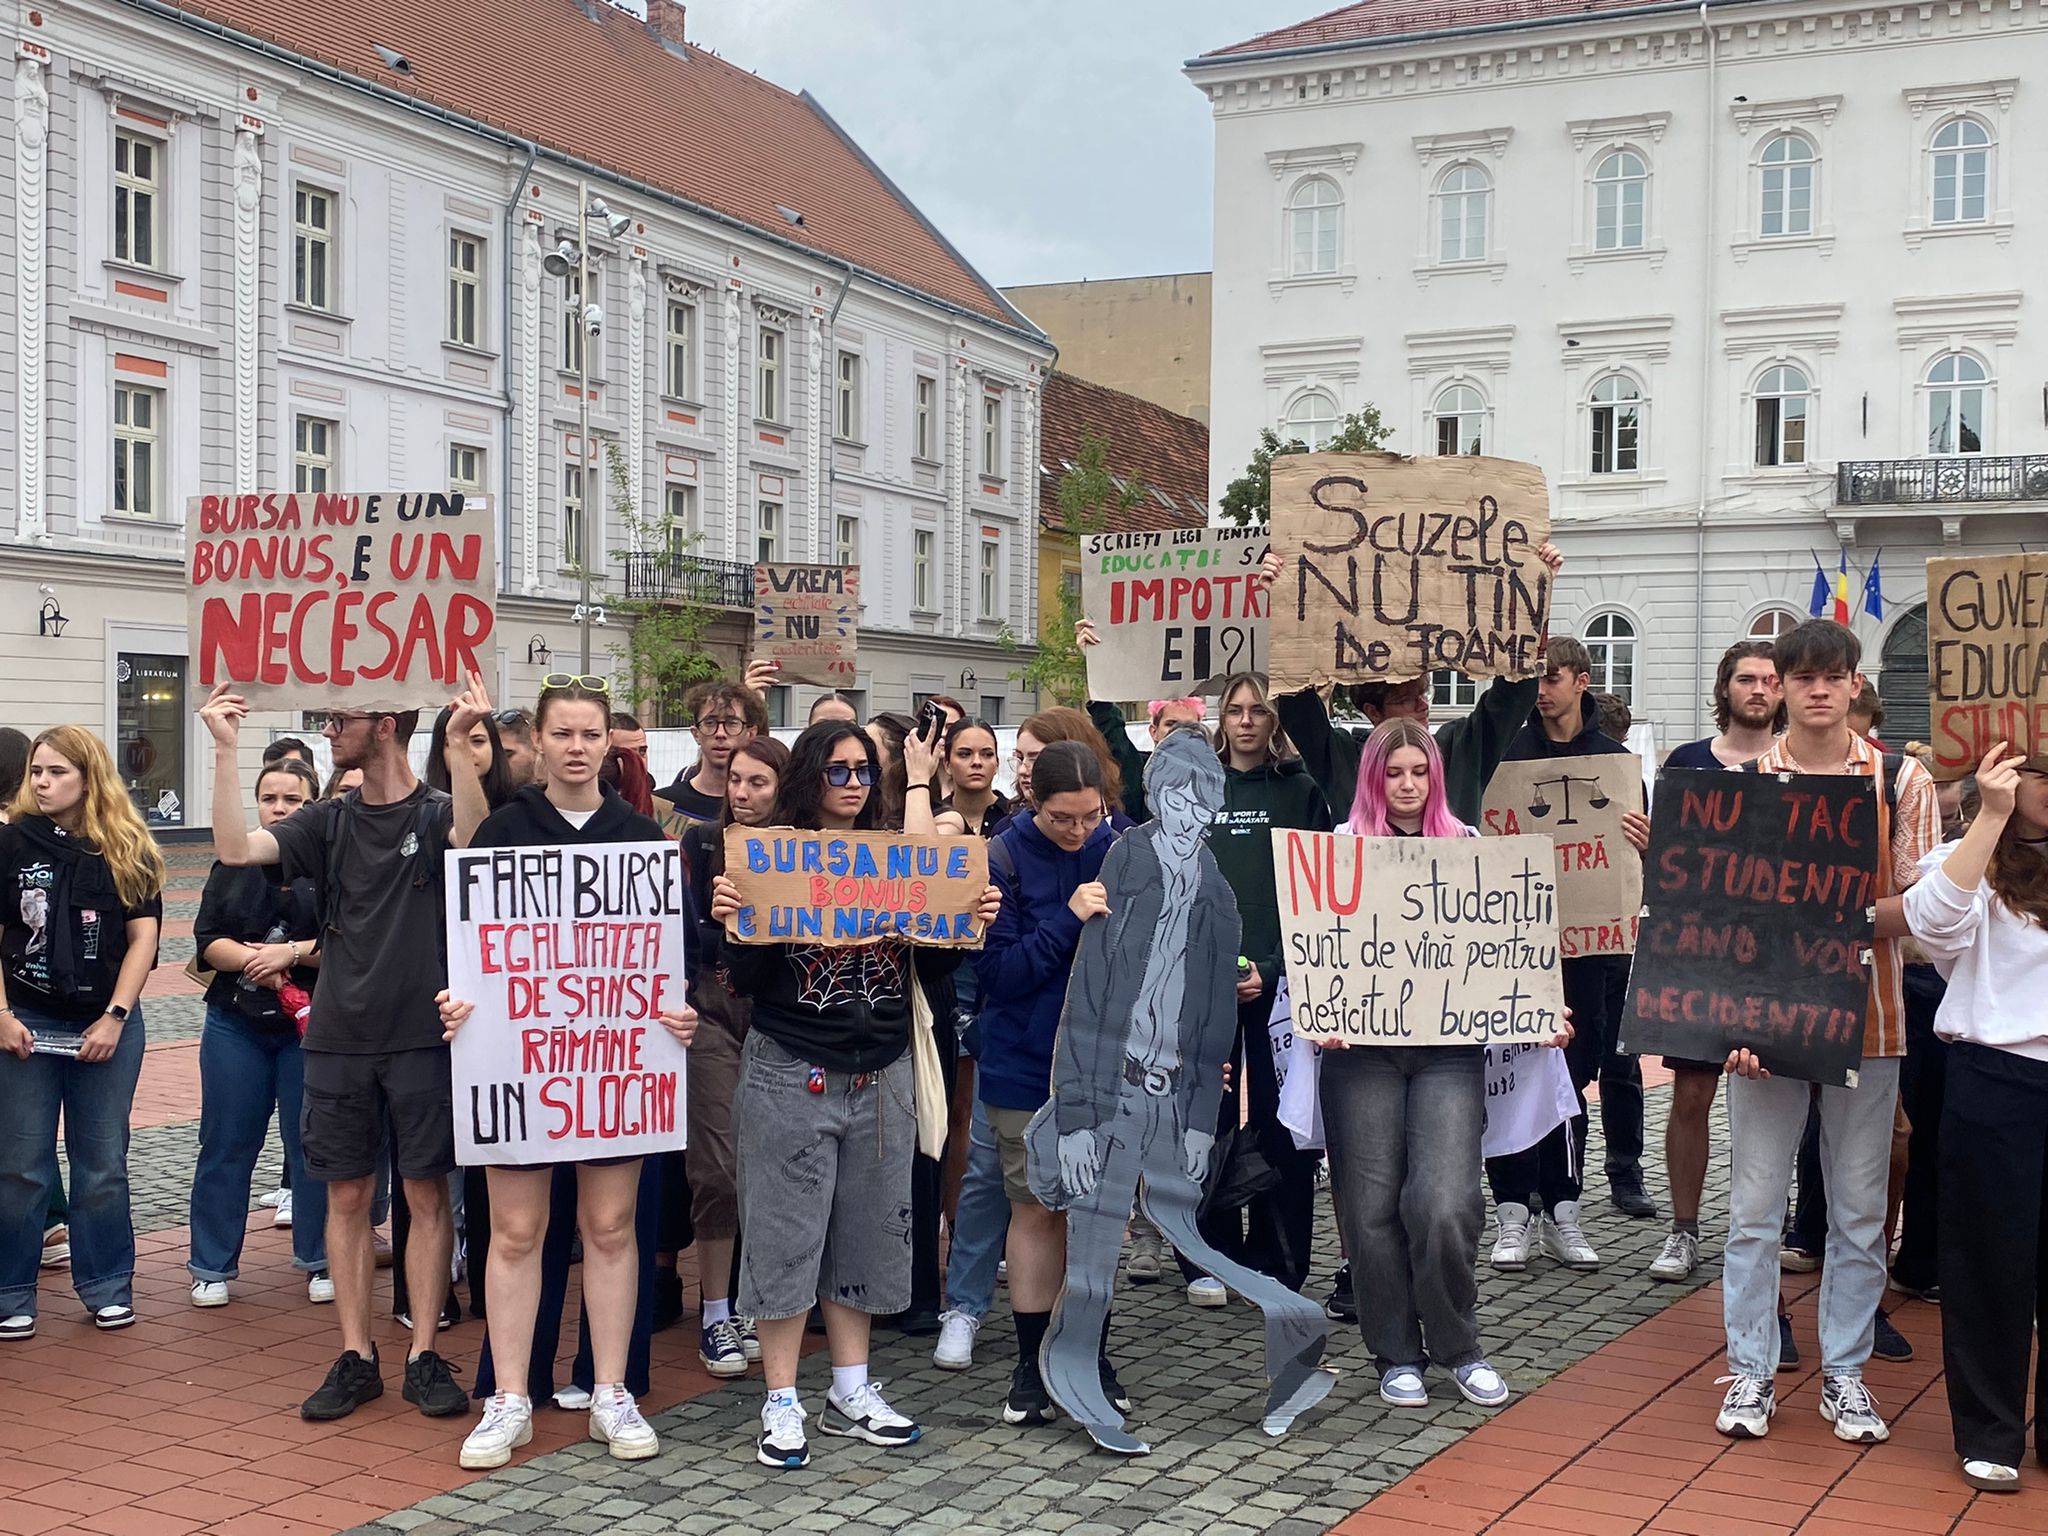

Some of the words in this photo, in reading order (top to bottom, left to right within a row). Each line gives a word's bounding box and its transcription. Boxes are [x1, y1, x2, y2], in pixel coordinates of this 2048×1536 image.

[200, 494, 301, 534] BURSA
[313, 493, 360, 527] NU
[365, 495, 382, 523] E
[397, 493, 465, 521] UN
[1172, 530, 1202, 545] LEGI
[1302, 475, 1529, 568] Scuzele
[351, 535, 373, 582] E
[390, 532, 481, 580] UN
[768, 568, 844, 595] VREM
[1297, 552, 1419, 626] NU
[200, 590, 494, 687] NECESAR
[785, 615, 820, 640] NU
[1335, 620, 1391, 673] De
[136, 669, 179, 679] LIBRARIUM
[1680, 788, 1743, 832] NU
[1780, 791, 1865, 848] TAC
[572, 849, 681, 919] BURSE
[745, 837, 879, 879] BURSA
[886, 843, 939, 880] NU
[946, 846, 969, 879] E
[1287, 831, 1364, 917] NU
[808, 874, 928, 913] BONUS
[737, 904, 758, 938] E
[769, 904, 822, 938] UN
[833, 906, 977, 940] NECESAR
[1291, 915, 1351, 970] sunt
[1360, 913, 1396, 969] de
[1404, 930, 1455, 971] vină
[1463, 924, 1557, 986] pentru
[507, 976, 551, 1021] DE
[1299, 973, 1414, 1038] deficitul
[1440, 977, 1558, 1042] bugetar
[471, 1082, 528, 1145] UN
[539, 1071, 677, 1140] SLOGAN
